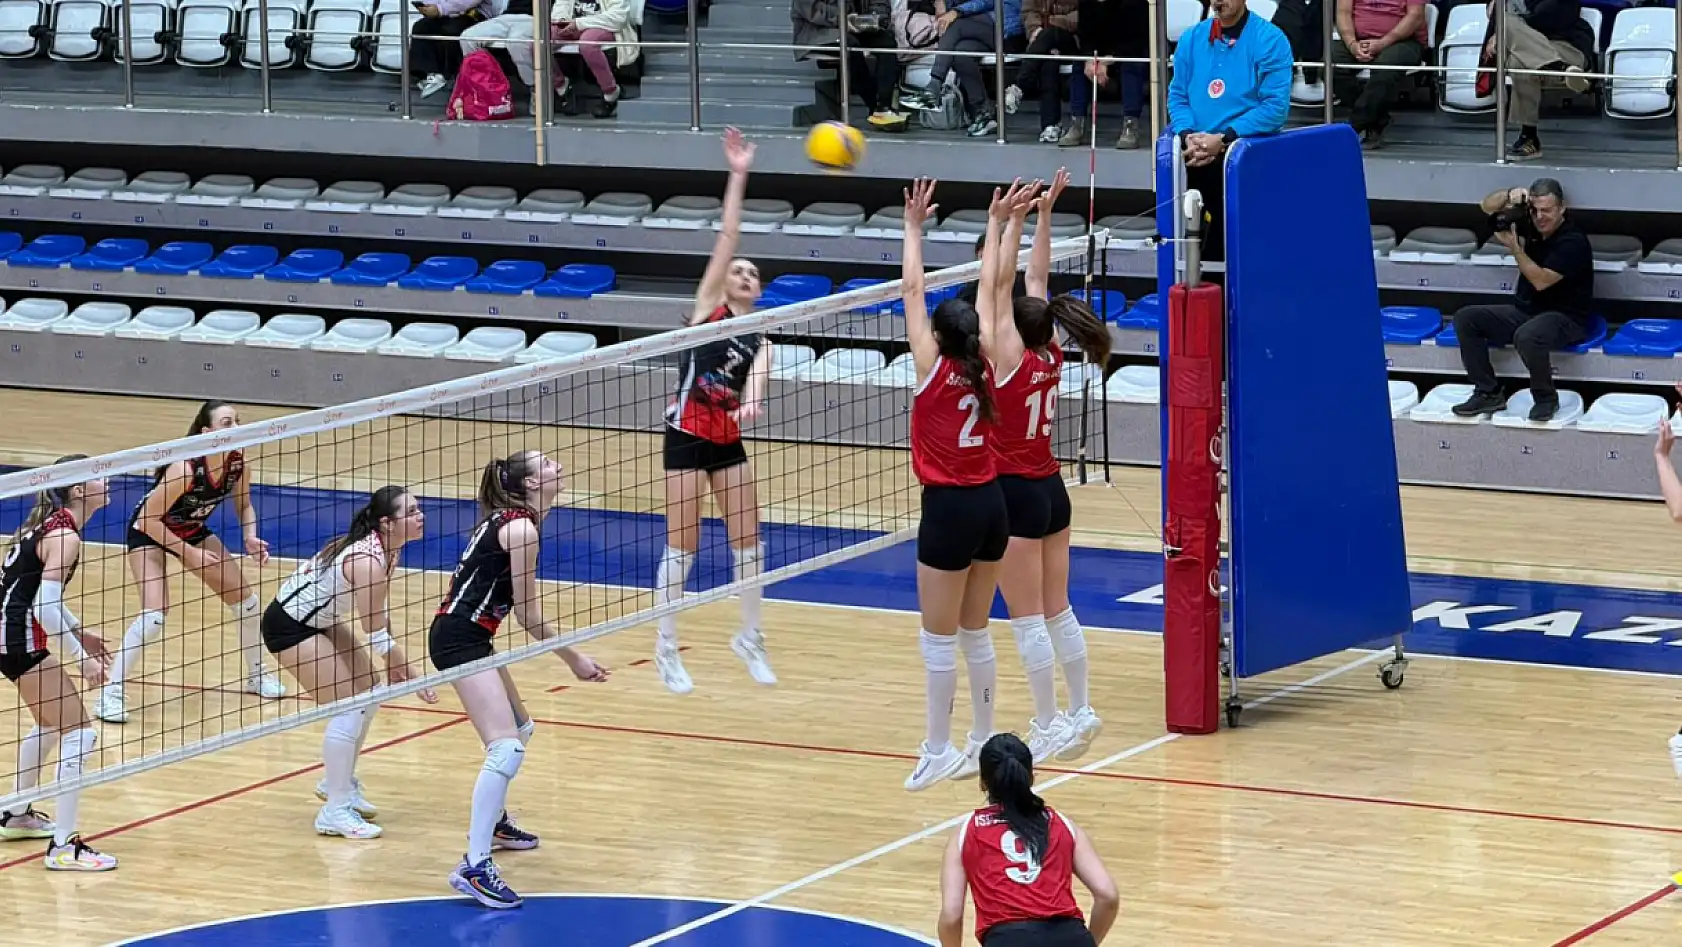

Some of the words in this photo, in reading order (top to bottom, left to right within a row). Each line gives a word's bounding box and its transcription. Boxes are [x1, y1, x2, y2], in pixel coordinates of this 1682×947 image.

[958, 393, 984, 448] 2
[1025, 385, 1058, 440] 19
[1413, 601, 1682, 647] KAZ
[1000, 830, 1042, 884] 9
